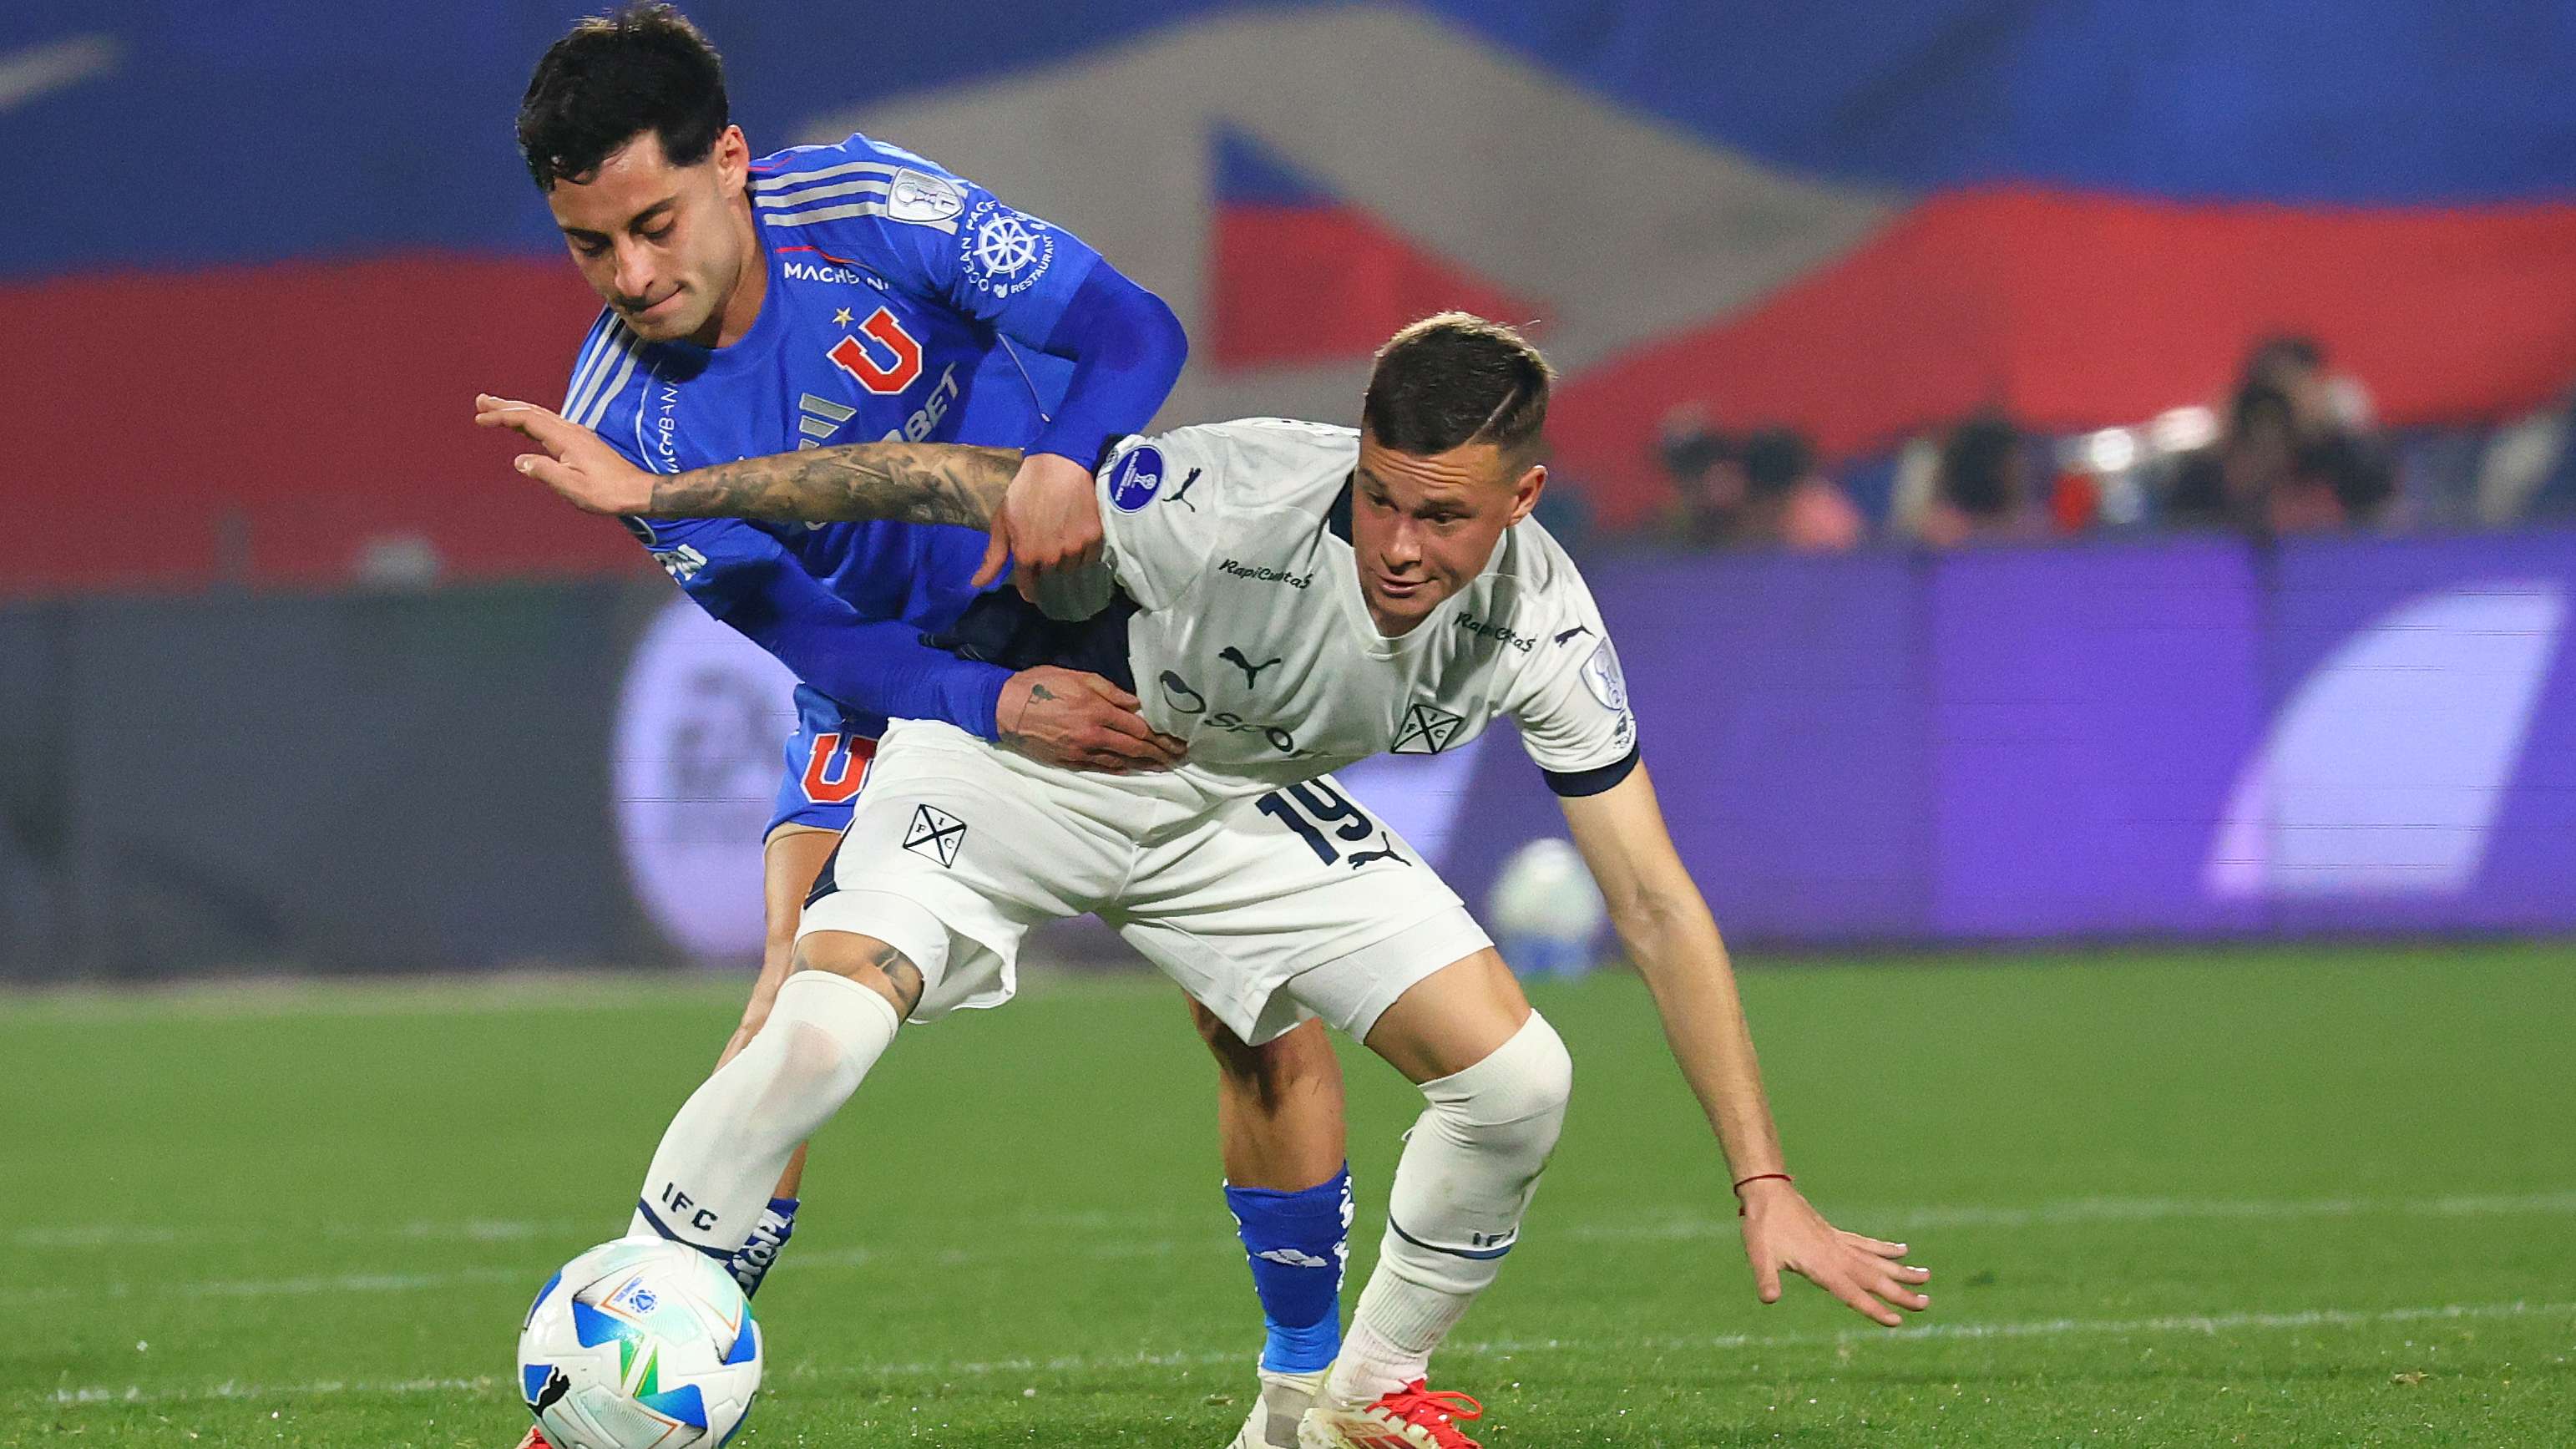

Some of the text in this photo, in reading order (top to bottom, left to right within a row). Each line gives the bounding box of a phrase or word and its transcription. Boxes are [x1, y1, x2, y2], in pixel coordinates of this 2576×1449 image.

[784, 261, 889, 291] MACHBN
[1010, 235, 1054, 294] RESTAURANT
[827, 306, 923, 395] U
[800, 732, 878, 804] U
[1255, 777, 1373, 866] 19
